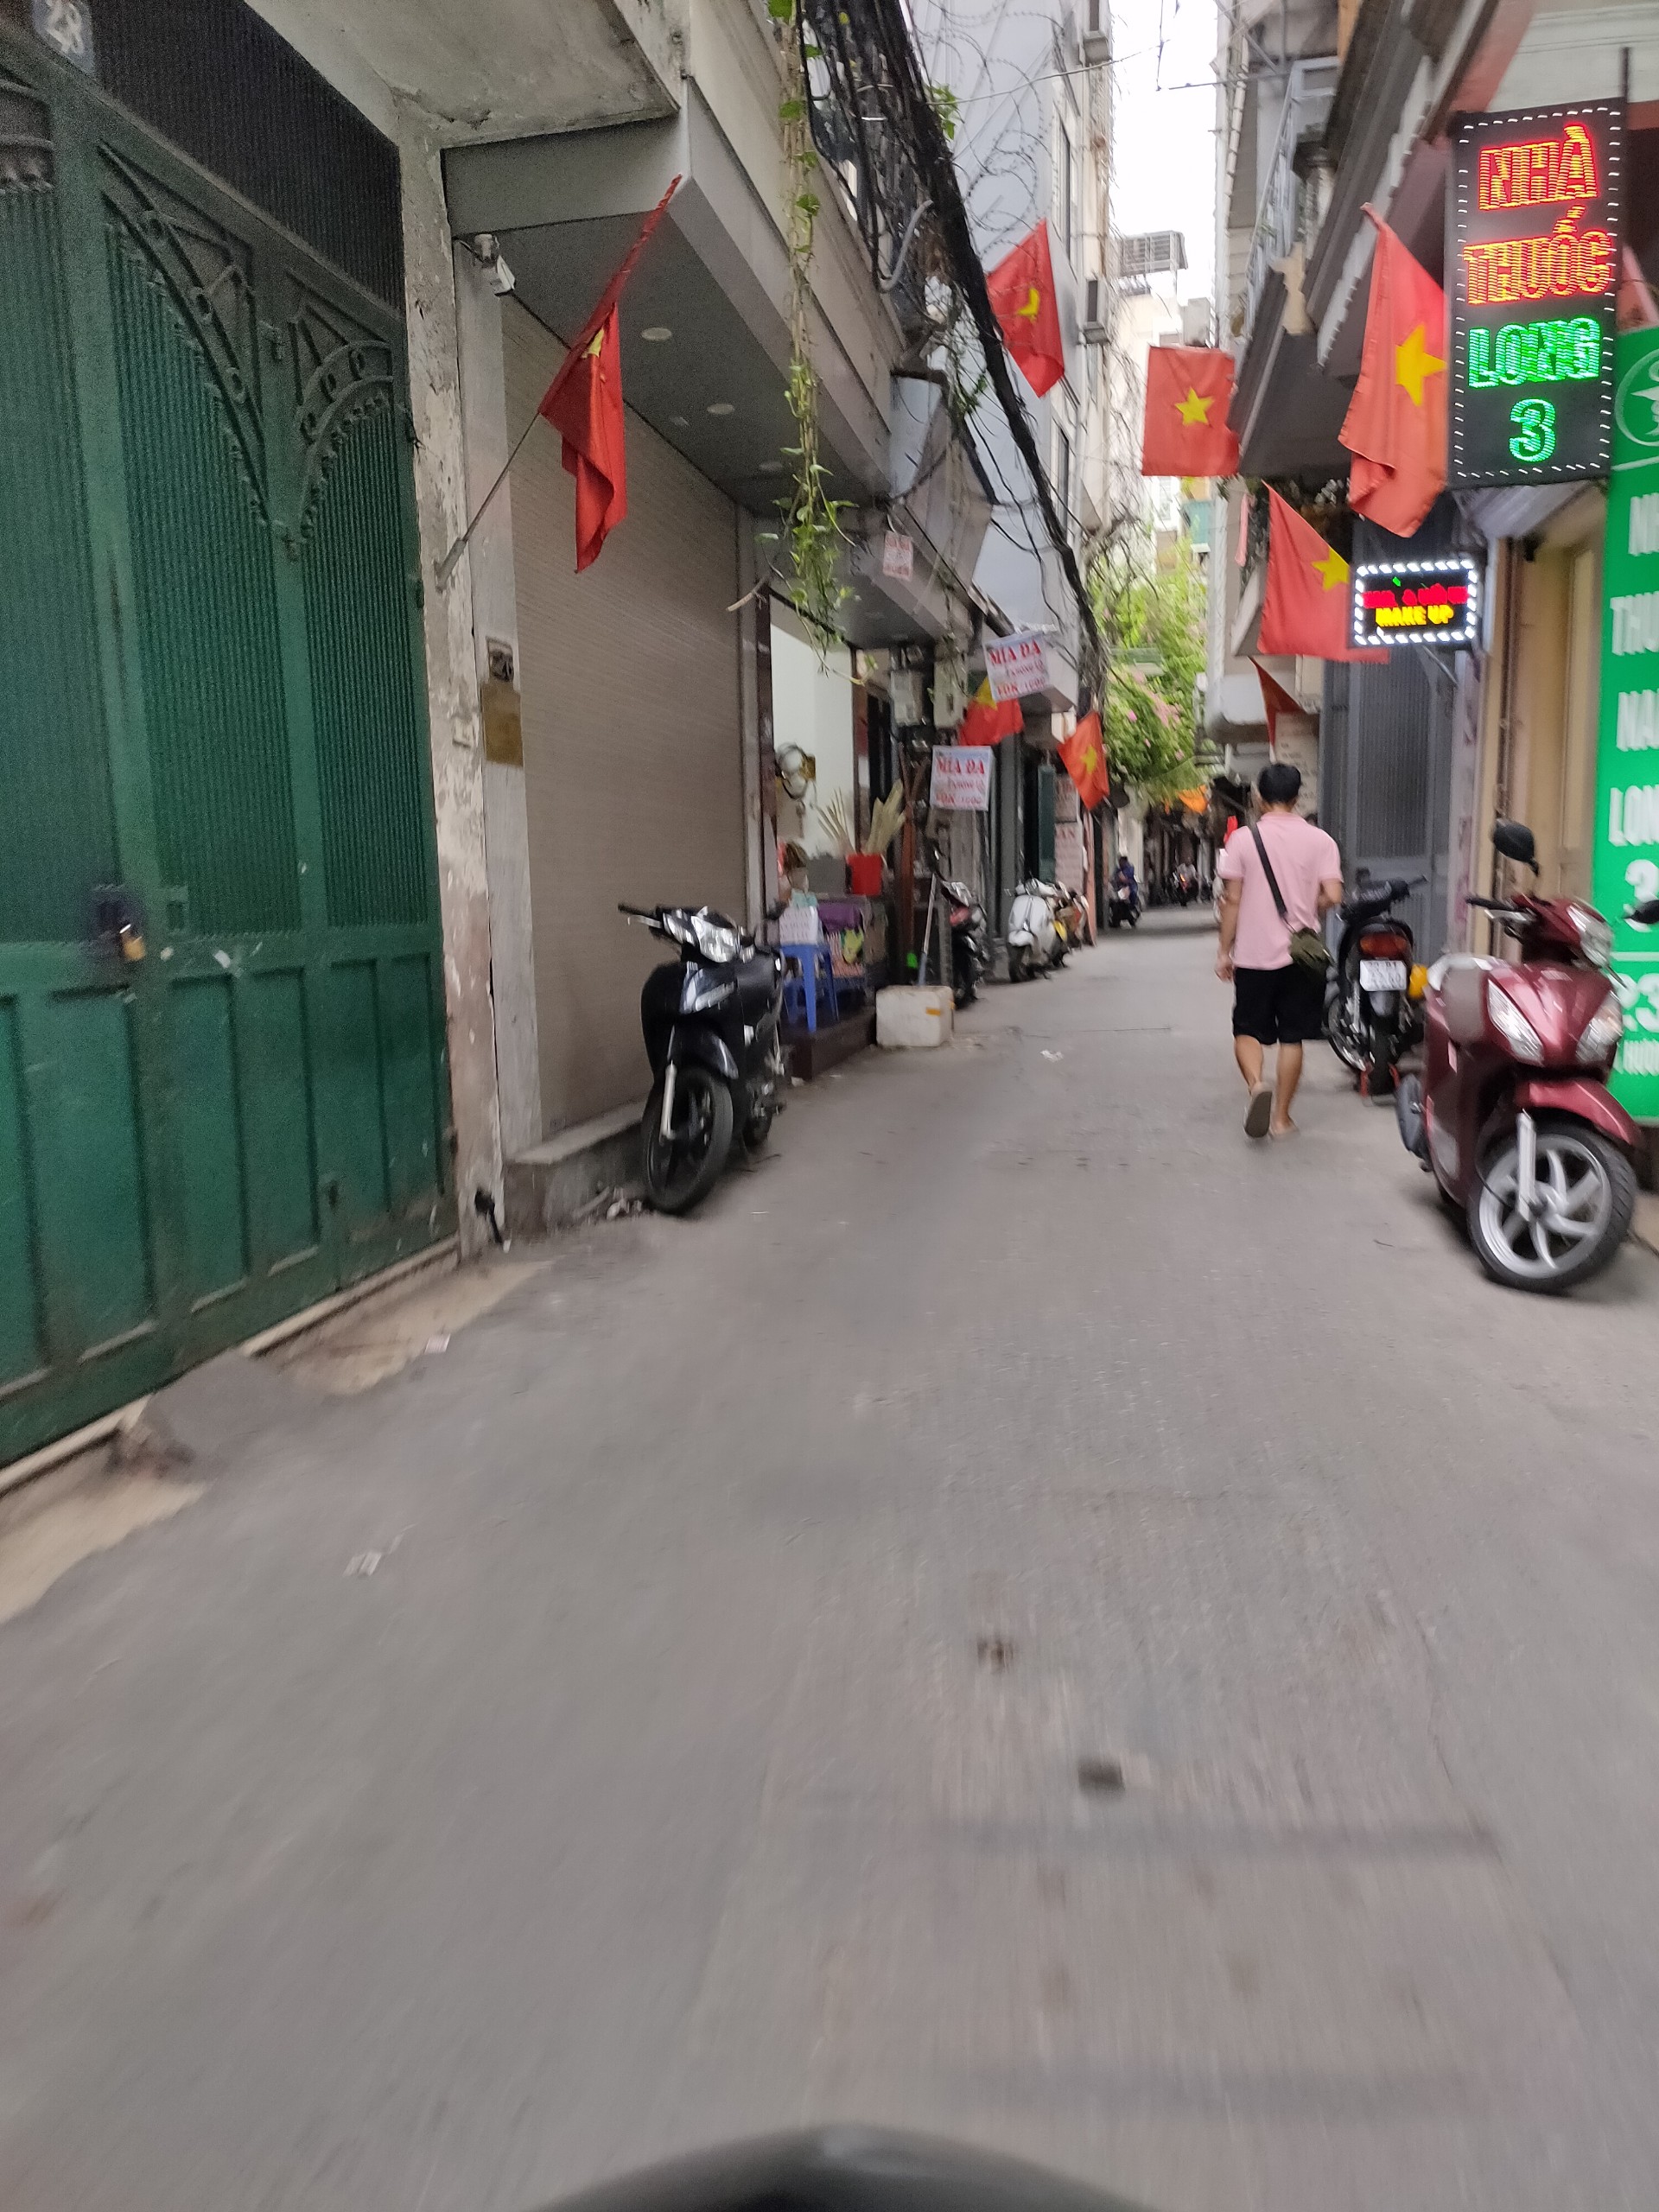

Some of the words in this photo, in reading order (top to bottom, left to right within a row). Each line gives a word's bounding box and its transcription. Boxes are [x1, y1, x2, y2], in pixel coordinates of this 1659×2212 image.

[1478, 124, 1599, 211] NHÀ
[1463, 205, 1613, 305] THUỐC
[1468, 316, 1600, 388] LONG
[1509, 398, 1555, 462] 3
[1427, 604, 1454, 625] UP
